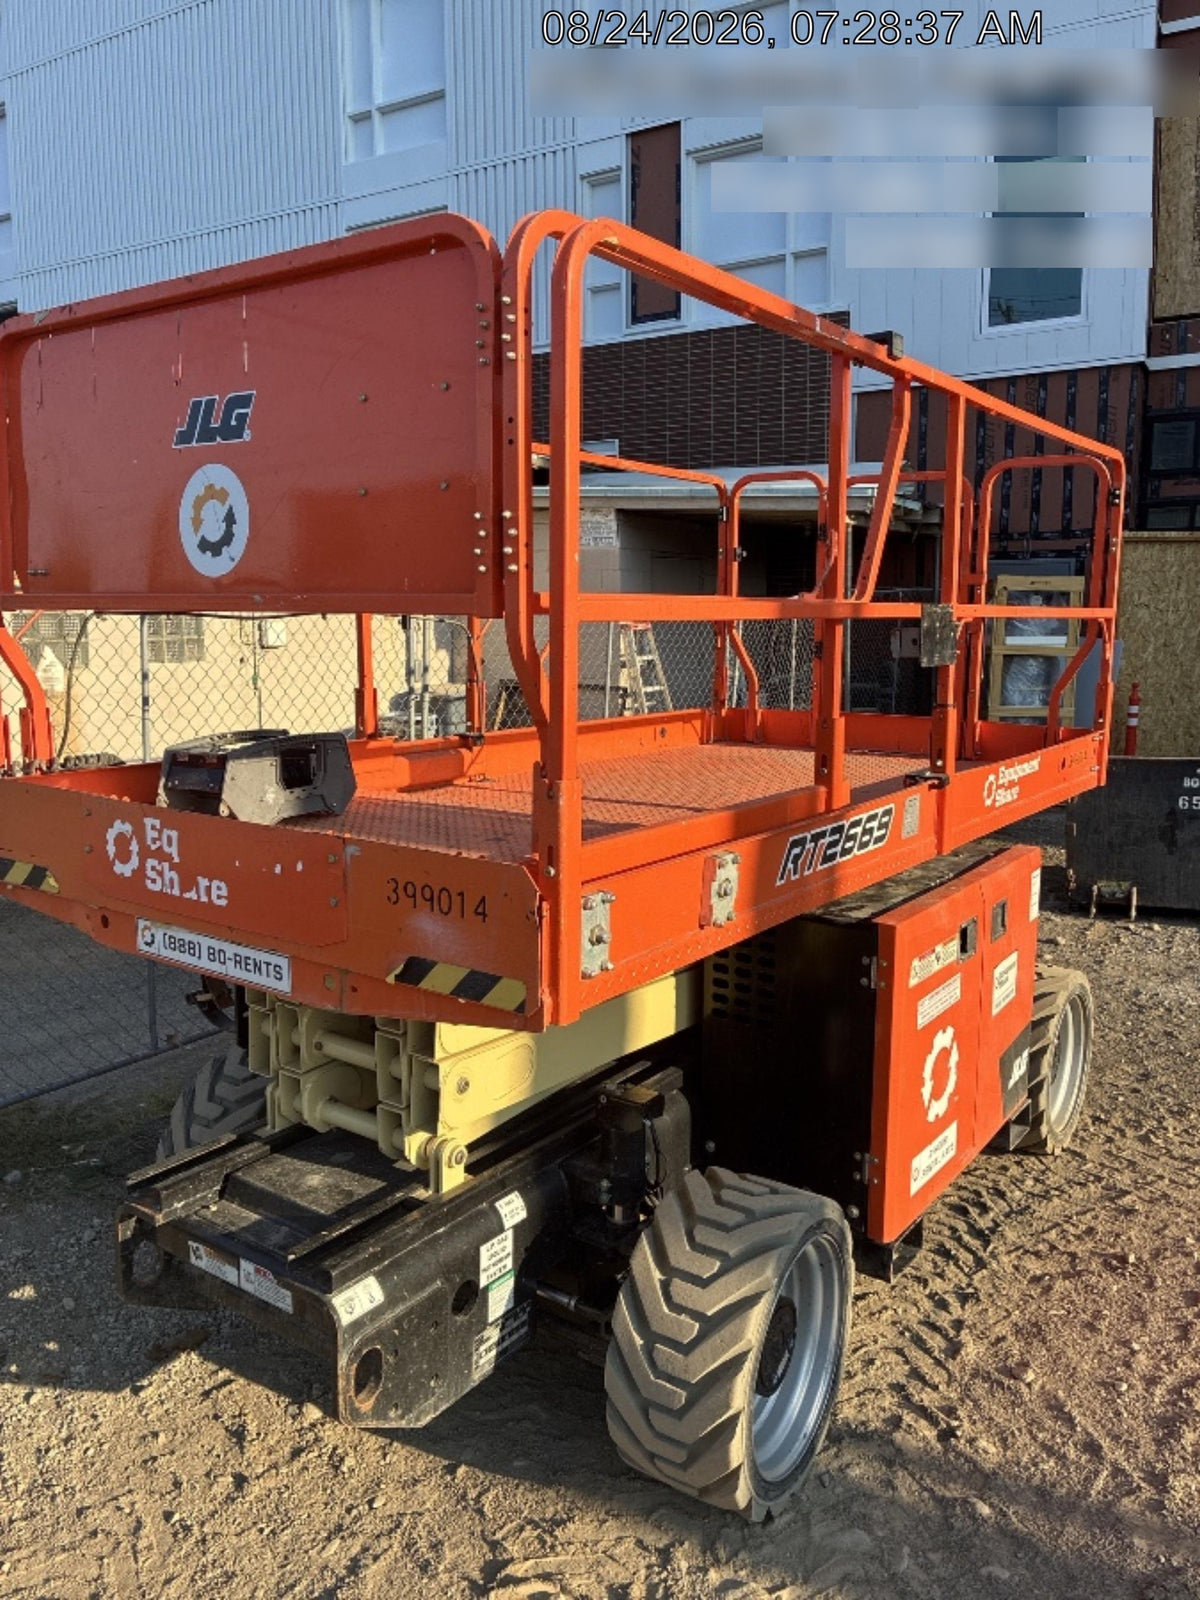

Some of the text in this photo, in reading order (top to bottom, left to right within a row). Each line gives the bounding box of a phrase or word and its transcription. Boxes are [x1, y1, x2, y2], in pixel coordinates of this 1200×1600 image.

[172, 390, 256, 448] JLG
[775, 803, 895, 887] RT2669
[386, 877, 488, 923] 399014
[162, 932, 202, 960] (888)
